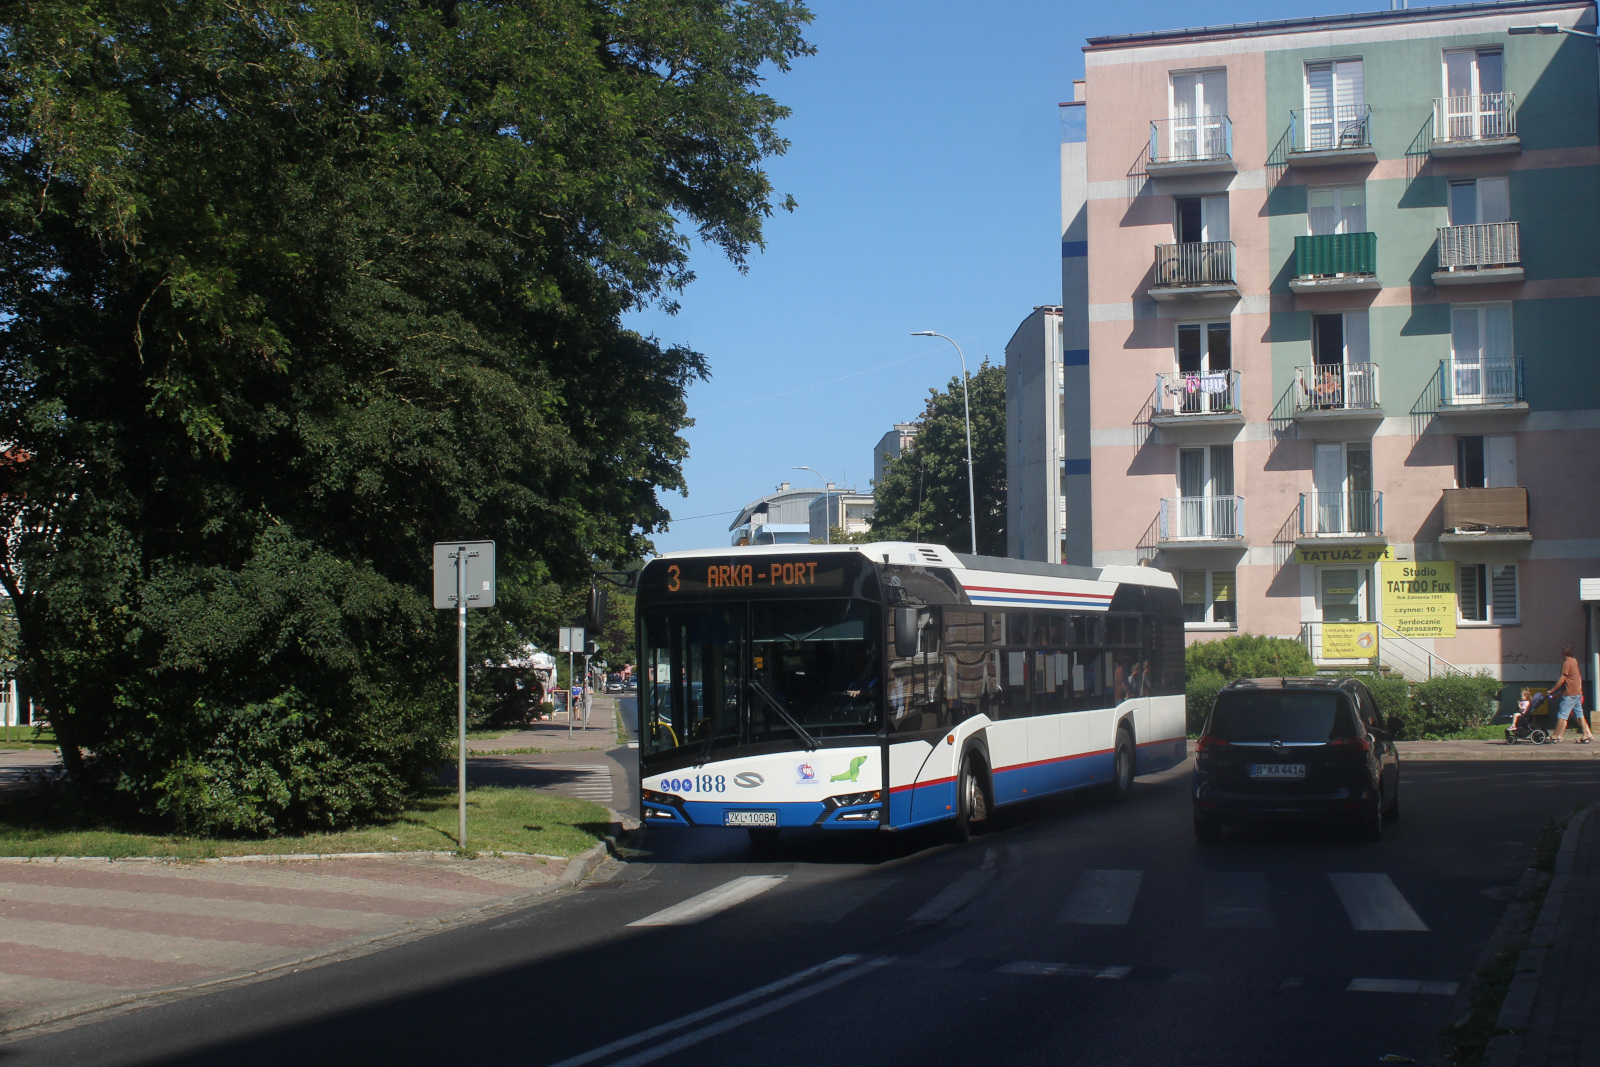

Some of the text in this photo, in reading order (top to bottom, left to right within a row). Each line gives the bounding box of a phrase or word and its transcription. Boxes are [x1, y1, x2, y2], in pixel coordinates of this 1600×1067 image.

[1300, 547, 1390, 561] TATUAŻ art
[667, 564, 681, 592] 3
[707, 564, 753, 588] ARKA
[770, 562, 818, 586] PORT
[1402, 567, 1437, 577] Studio
[1386, 579, 1451, 593] TATTOO Fux
[1256, 765, 1263, 775] B
[1281, 765, 1304, 775] 4414
[695, 774, 726, 793] 188
[729, 812, 746, 823] ZKL
